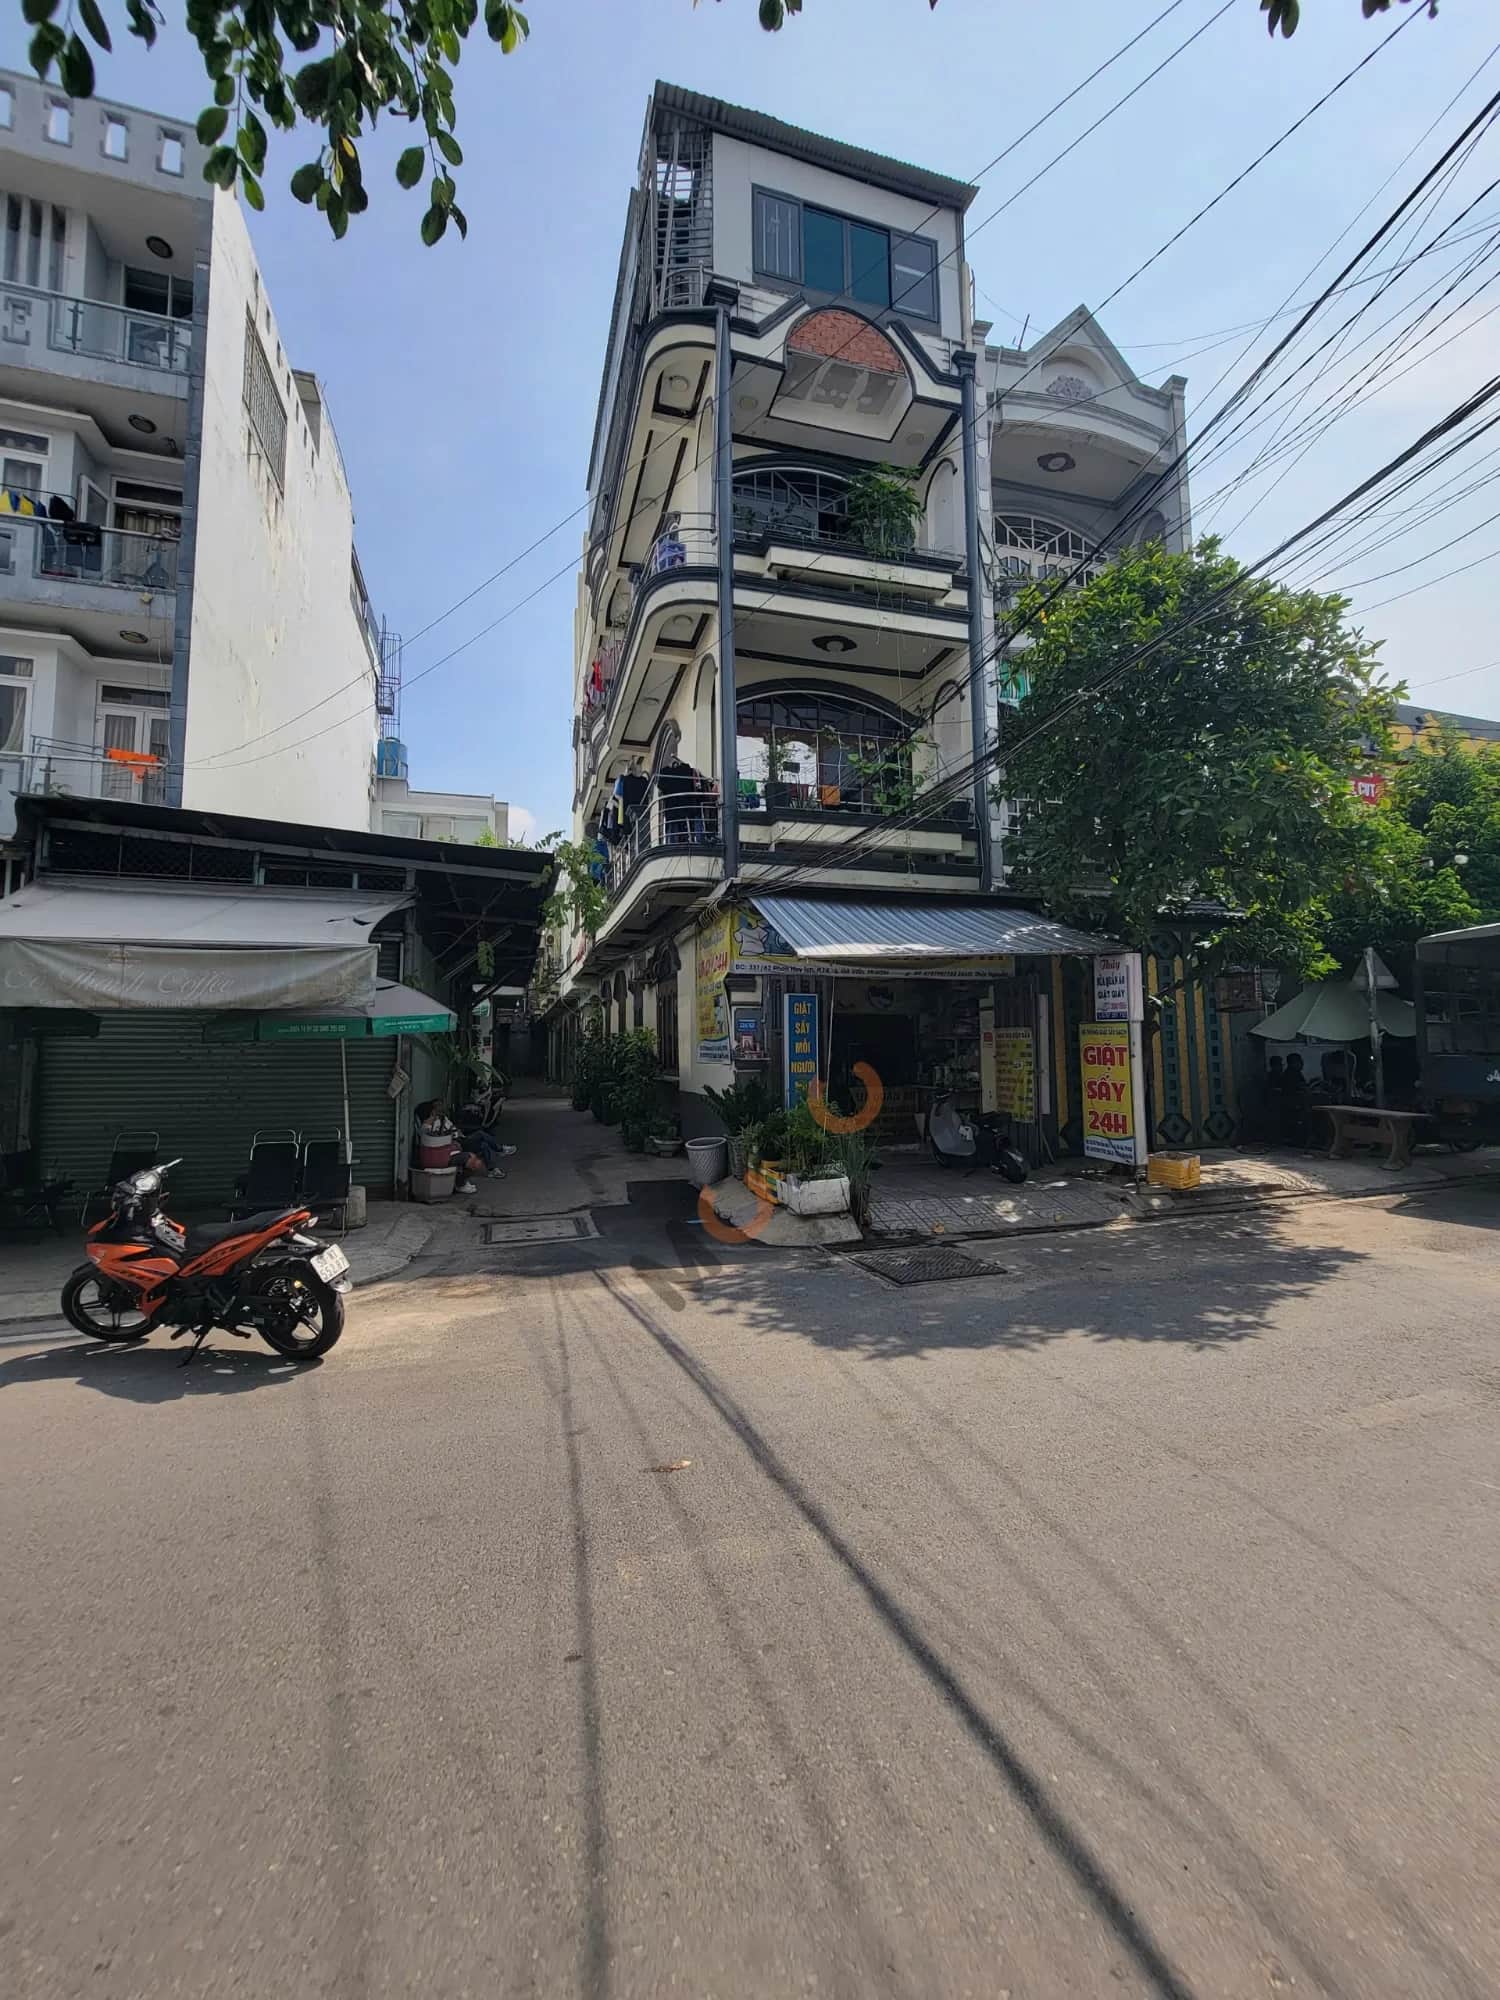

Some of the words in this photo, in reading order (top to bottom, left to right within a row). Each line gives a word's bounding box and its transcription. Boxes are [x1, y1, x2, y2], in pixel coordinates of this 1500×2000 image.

[1083, 1042, 1127, 1070] GIẶT
[1087, 1074, 1126, 1102] SẤY
[1088, 1110, 1127, 1134] 24H
